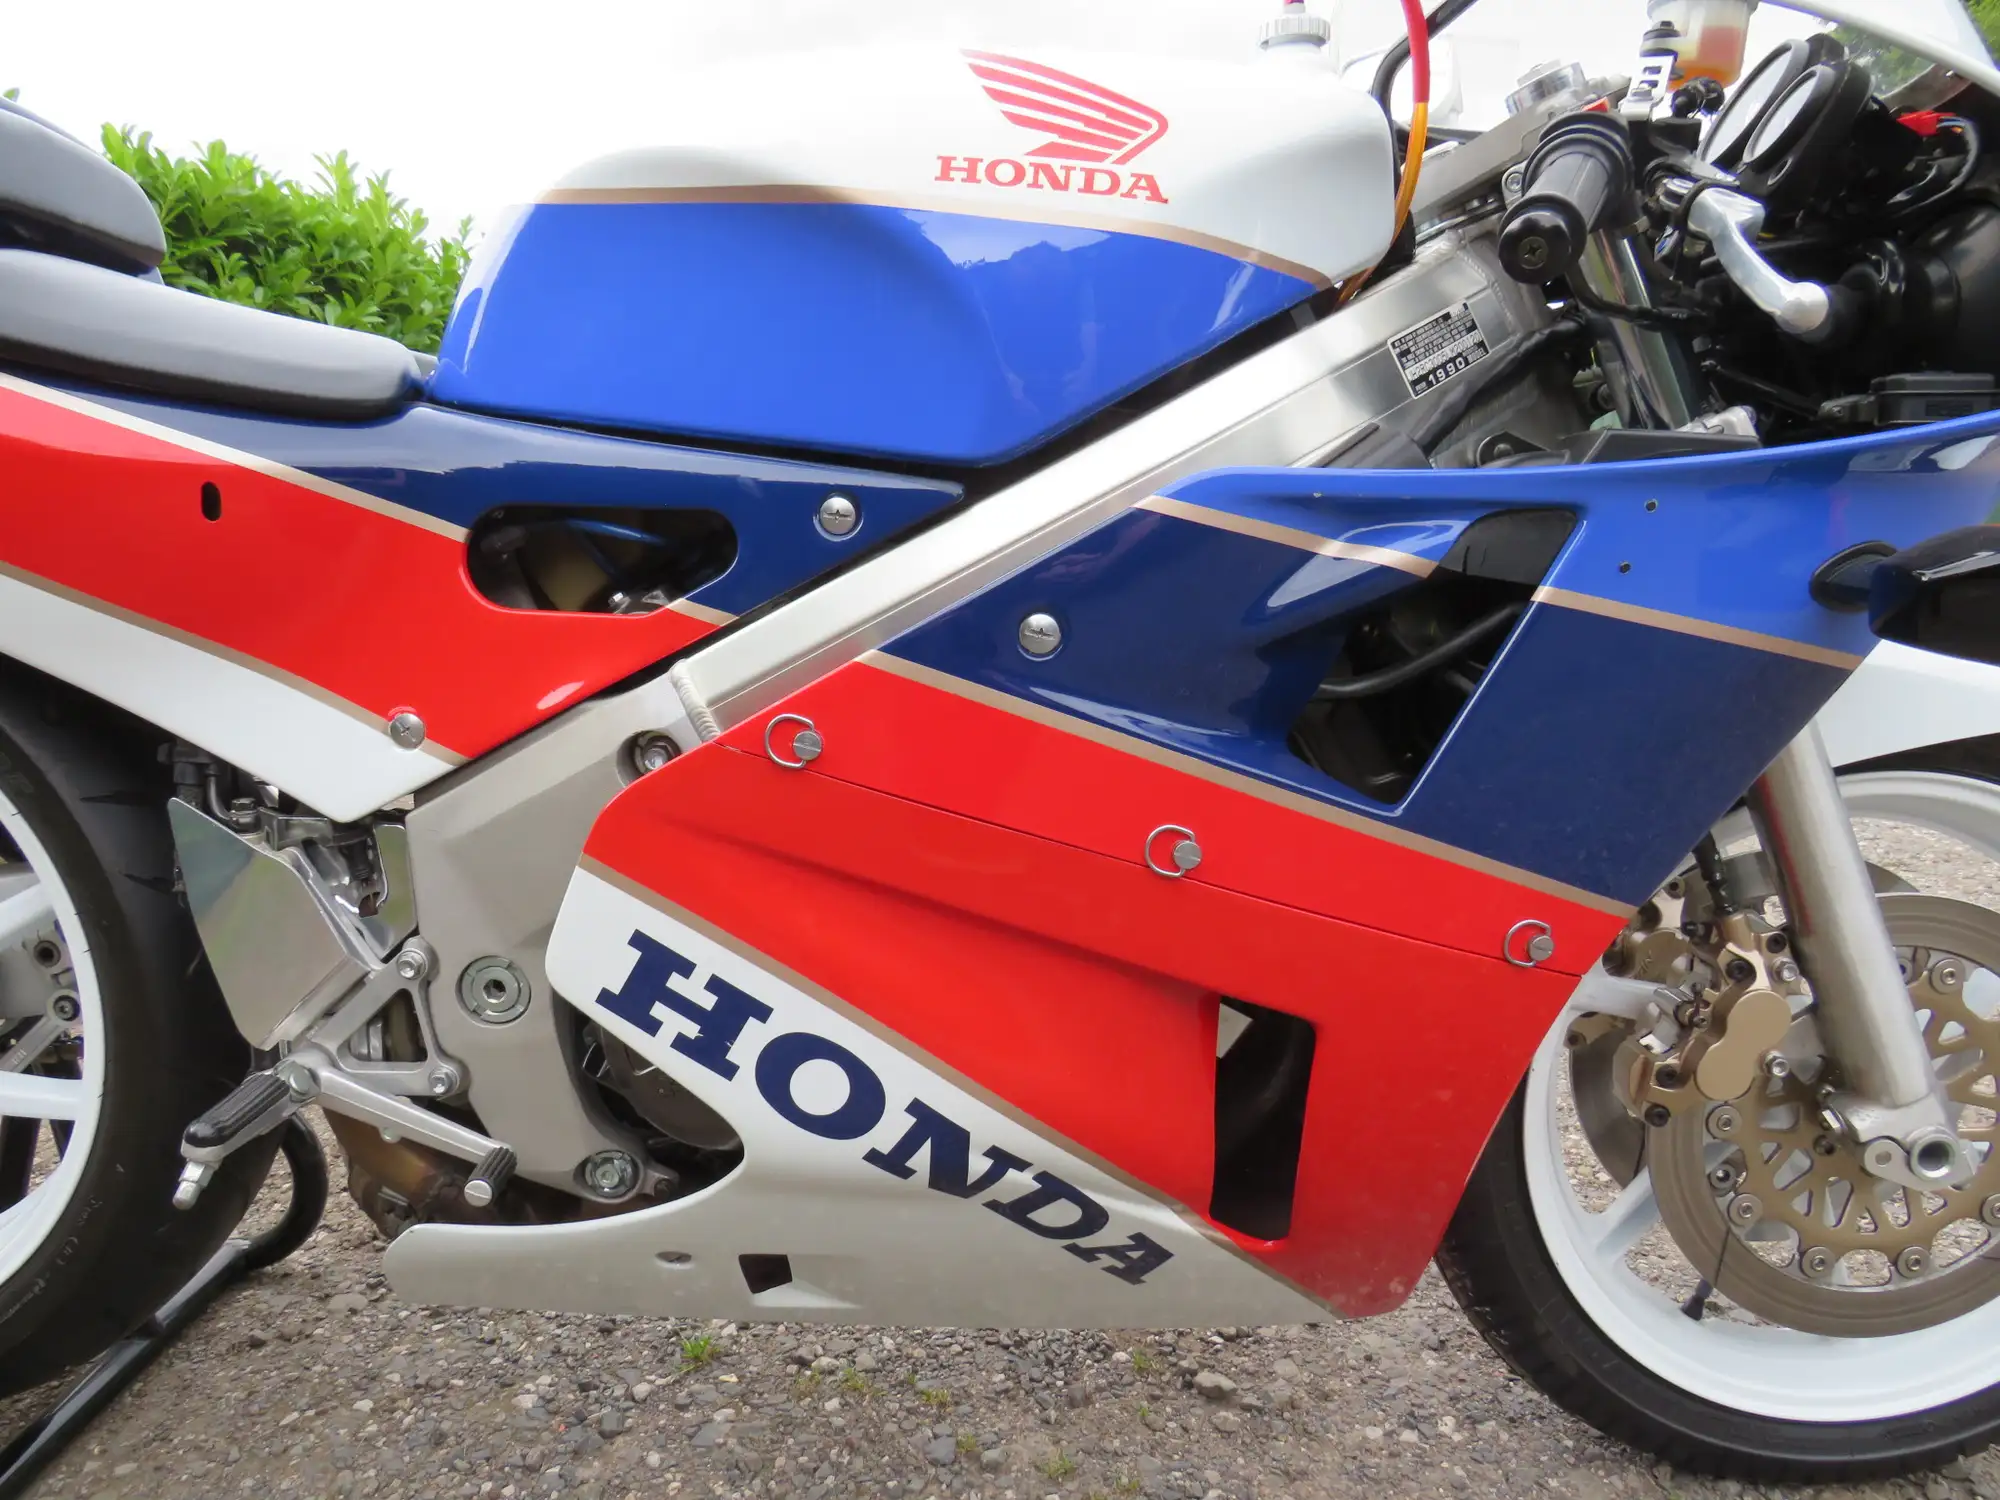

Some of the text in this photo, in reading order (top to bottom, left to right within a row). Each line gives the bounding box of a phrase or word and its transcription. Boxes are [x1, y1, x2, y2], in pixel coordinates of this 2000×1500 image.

[934, 155, 1169, 204] HONDA
[1428, 356, 1465, 386] 1990
[595, 929, 1174, 1286] HONDA
